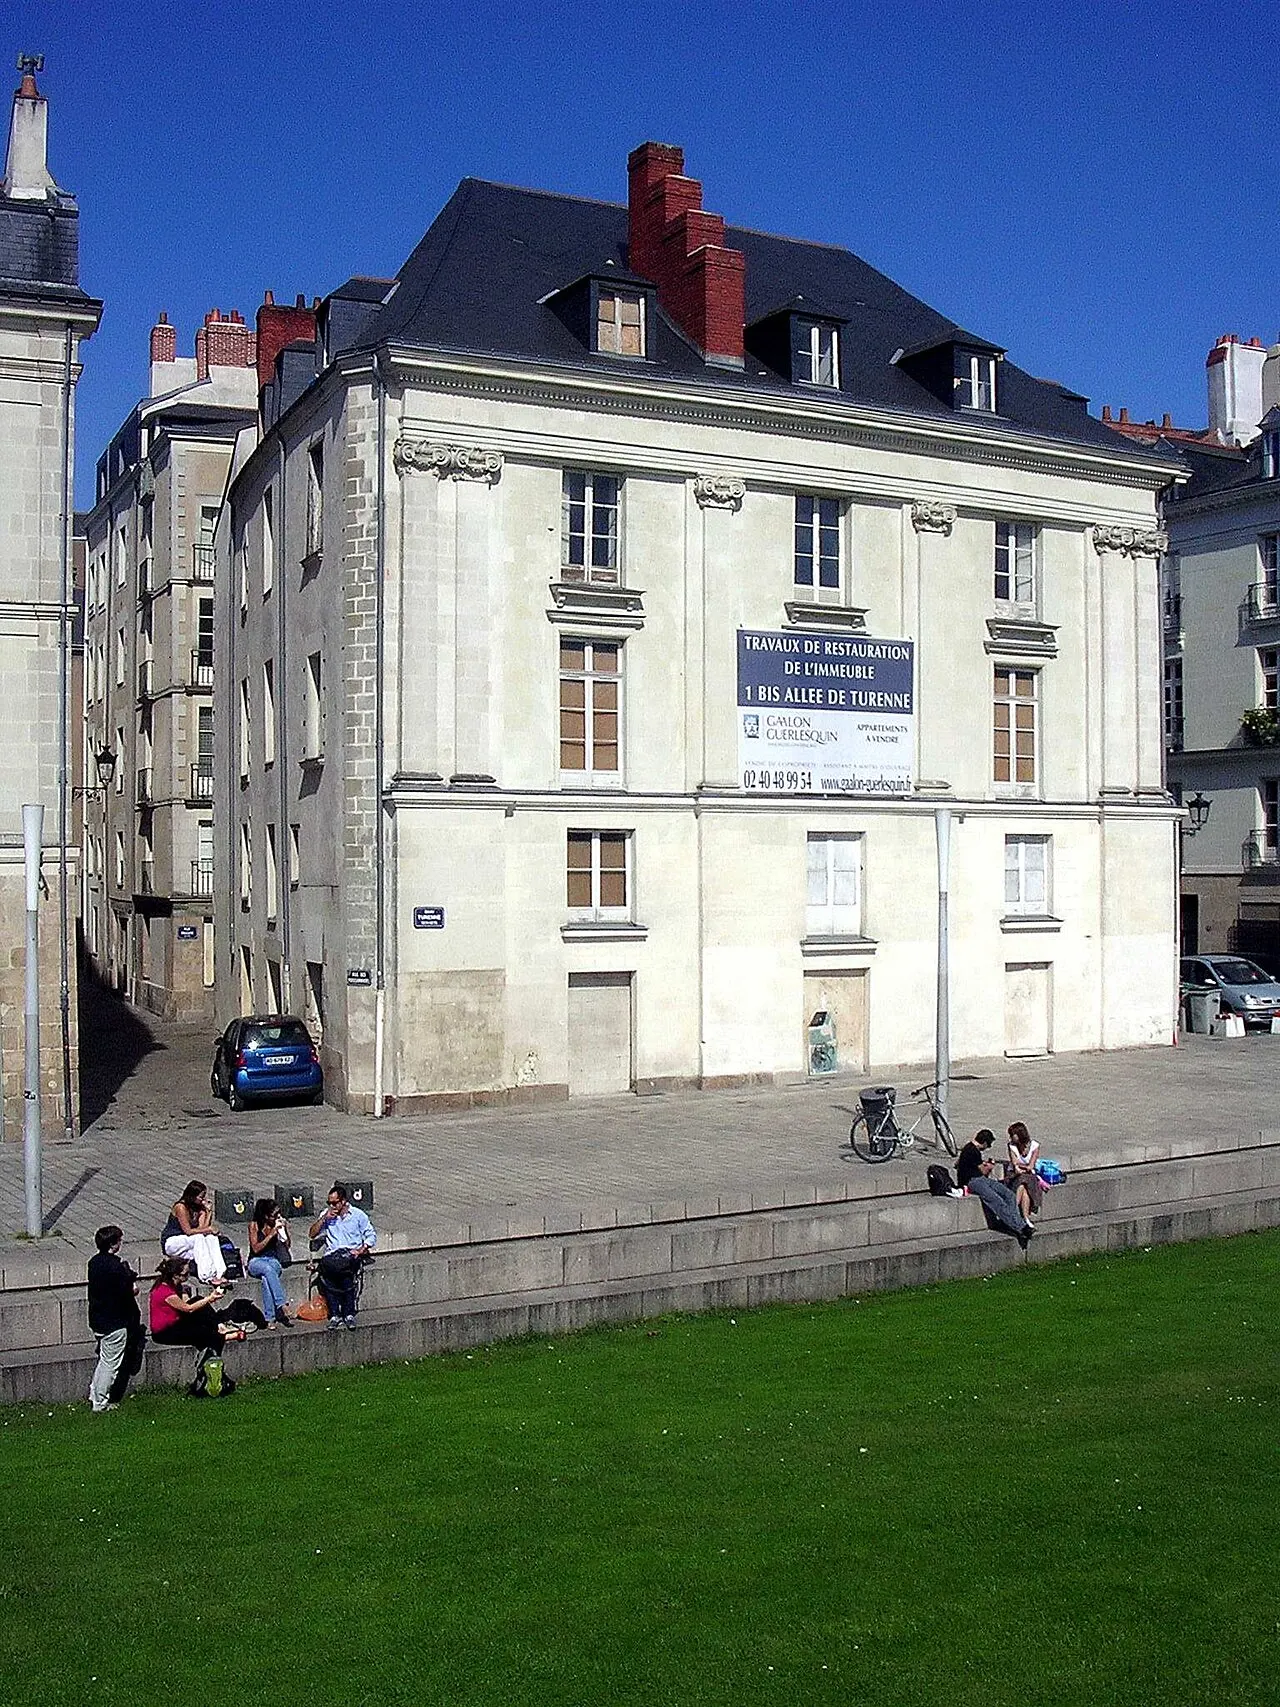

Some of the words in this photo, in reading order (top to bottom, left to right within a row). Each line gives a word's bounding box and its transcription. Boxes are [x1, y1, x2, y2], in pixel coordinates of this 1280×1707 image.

[744, 635, 800, 653] TRAVAUX
[804, 640, 820, 654] DE
[825, 641, 910, 660] RESTAURATION
[784, 661, 801, 675] DE
[804, 662, 875, 680] L'IMMEUBLE
[745, 685, 752, 701] 1
[758, 685, 780, 702] BIS
[784, 687, 823, 704] ALLEE
[828, 690, 846, 705] DE
[849, 690, 911, 709] TURENNE
[766, 715, 811, 728] GAALON
[856, 723, 908, 733] APPARTEMENTS
[766, 728, 838, 745] GUERLESQUIN
[871, 735, 899, 744] VENDRE
[744, 770, 756, 788] 02
[758, 770, 771, 789] 40
[772, 771, 785, 789] 48
[786, 771, 798, 790] 99
[800, 771, 812, 790] 54
[820, 773, 912, 793] www.gaalon-guerlesquin.fr
